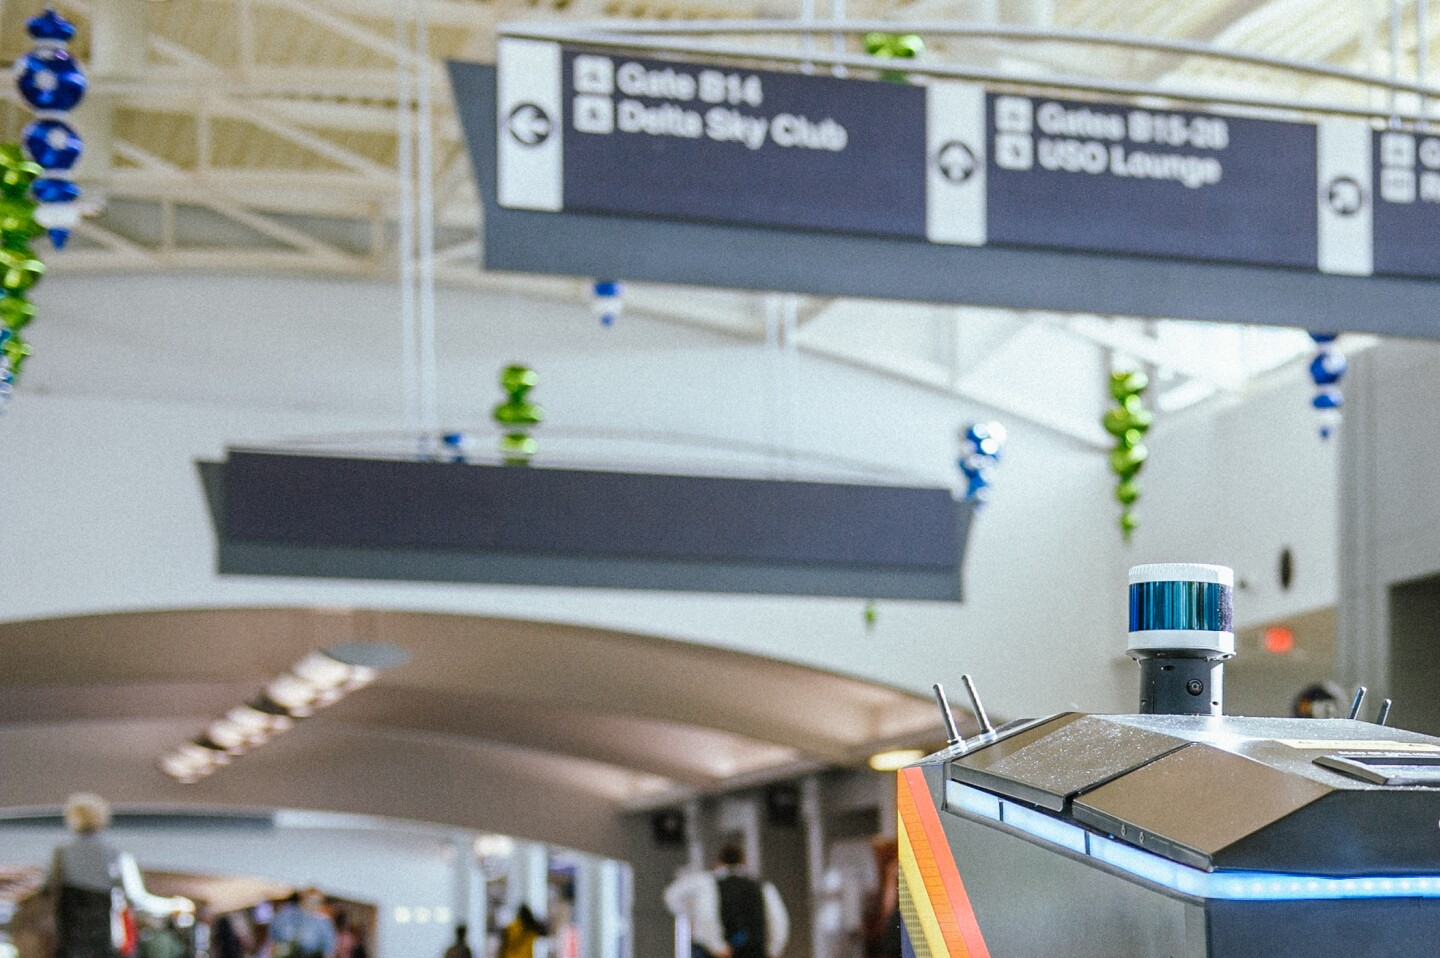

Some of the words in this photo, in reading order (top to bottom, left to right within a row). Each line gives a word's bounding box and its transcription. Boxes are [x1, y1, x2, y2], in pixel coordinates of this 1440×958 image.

[617, 62, 697, 101] Gate
[699, 70, 763, 107] B14
[617, 98, 703, 139] Delta
[704, 106, 769, 150] Sky
[770, 112, 846, 151] Club
[1036, 101, 1126, 141] Gates
[1037, 137, 1109, 175] USO
[1110, 143, 1223, 189] Lounge
